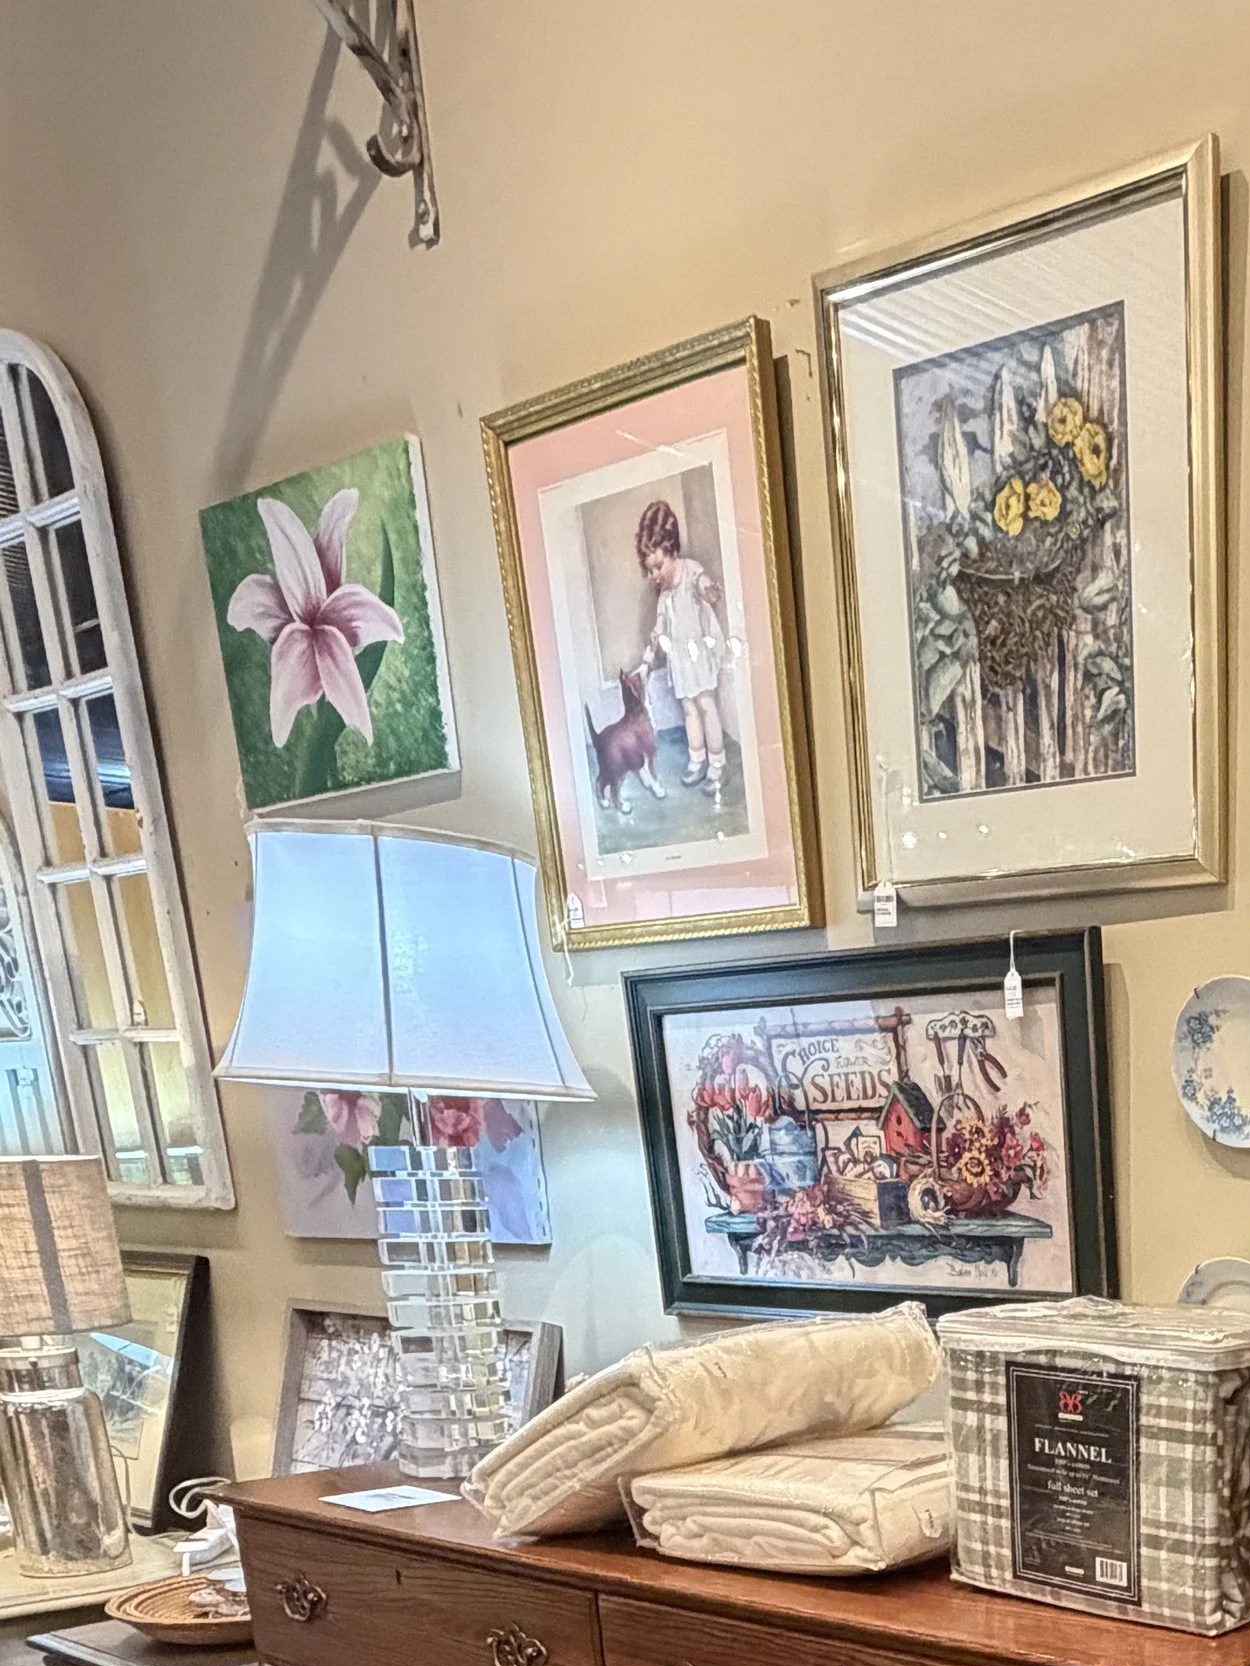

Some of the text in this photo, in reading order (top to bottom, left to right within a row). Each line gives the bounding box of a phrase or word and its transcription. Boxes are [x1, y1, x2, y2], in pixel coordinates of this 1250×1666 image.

[781, 1038, 839, 1090] CHOICE
[809, 1068, 892, 1104] SEEDS
[1034, 1437, 1112, 1463] FLANNEL
[1047, 1480, 1098, 1498] full sheet set
